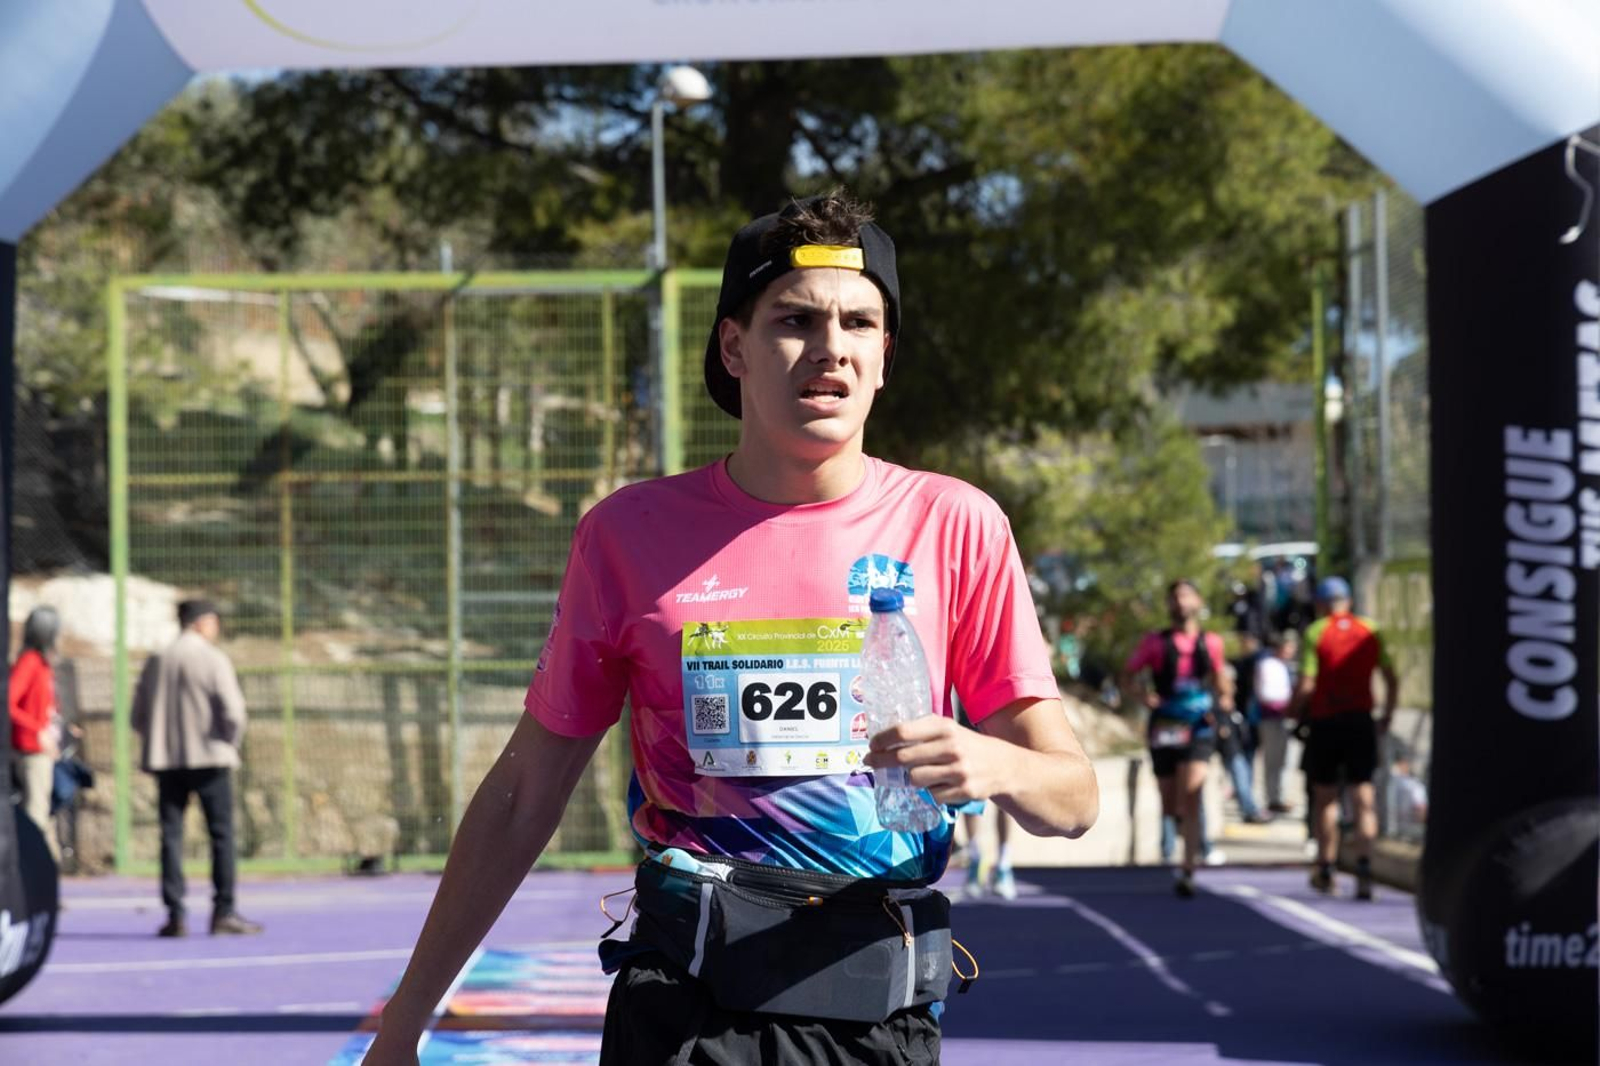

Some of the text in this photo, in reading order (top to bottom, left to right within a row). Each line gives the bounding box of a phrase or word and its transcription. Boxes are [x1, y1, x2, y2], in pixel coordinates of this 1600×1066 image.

[1504, 424, 1579, 722] CONSIGUE
[676, 586, 749, 604] TEAMERGY
[774, 632, 806, 641] Provincial
[817, 625, 850, 640] CxM
[817, 640, 850, 652] 2025
[687, 661, 700, 671] VII
[702, 660, 730, 671] TRAIL
[731, 659, 784, 670] SOLIDARIO
[741, 681, 838, 721] 626
